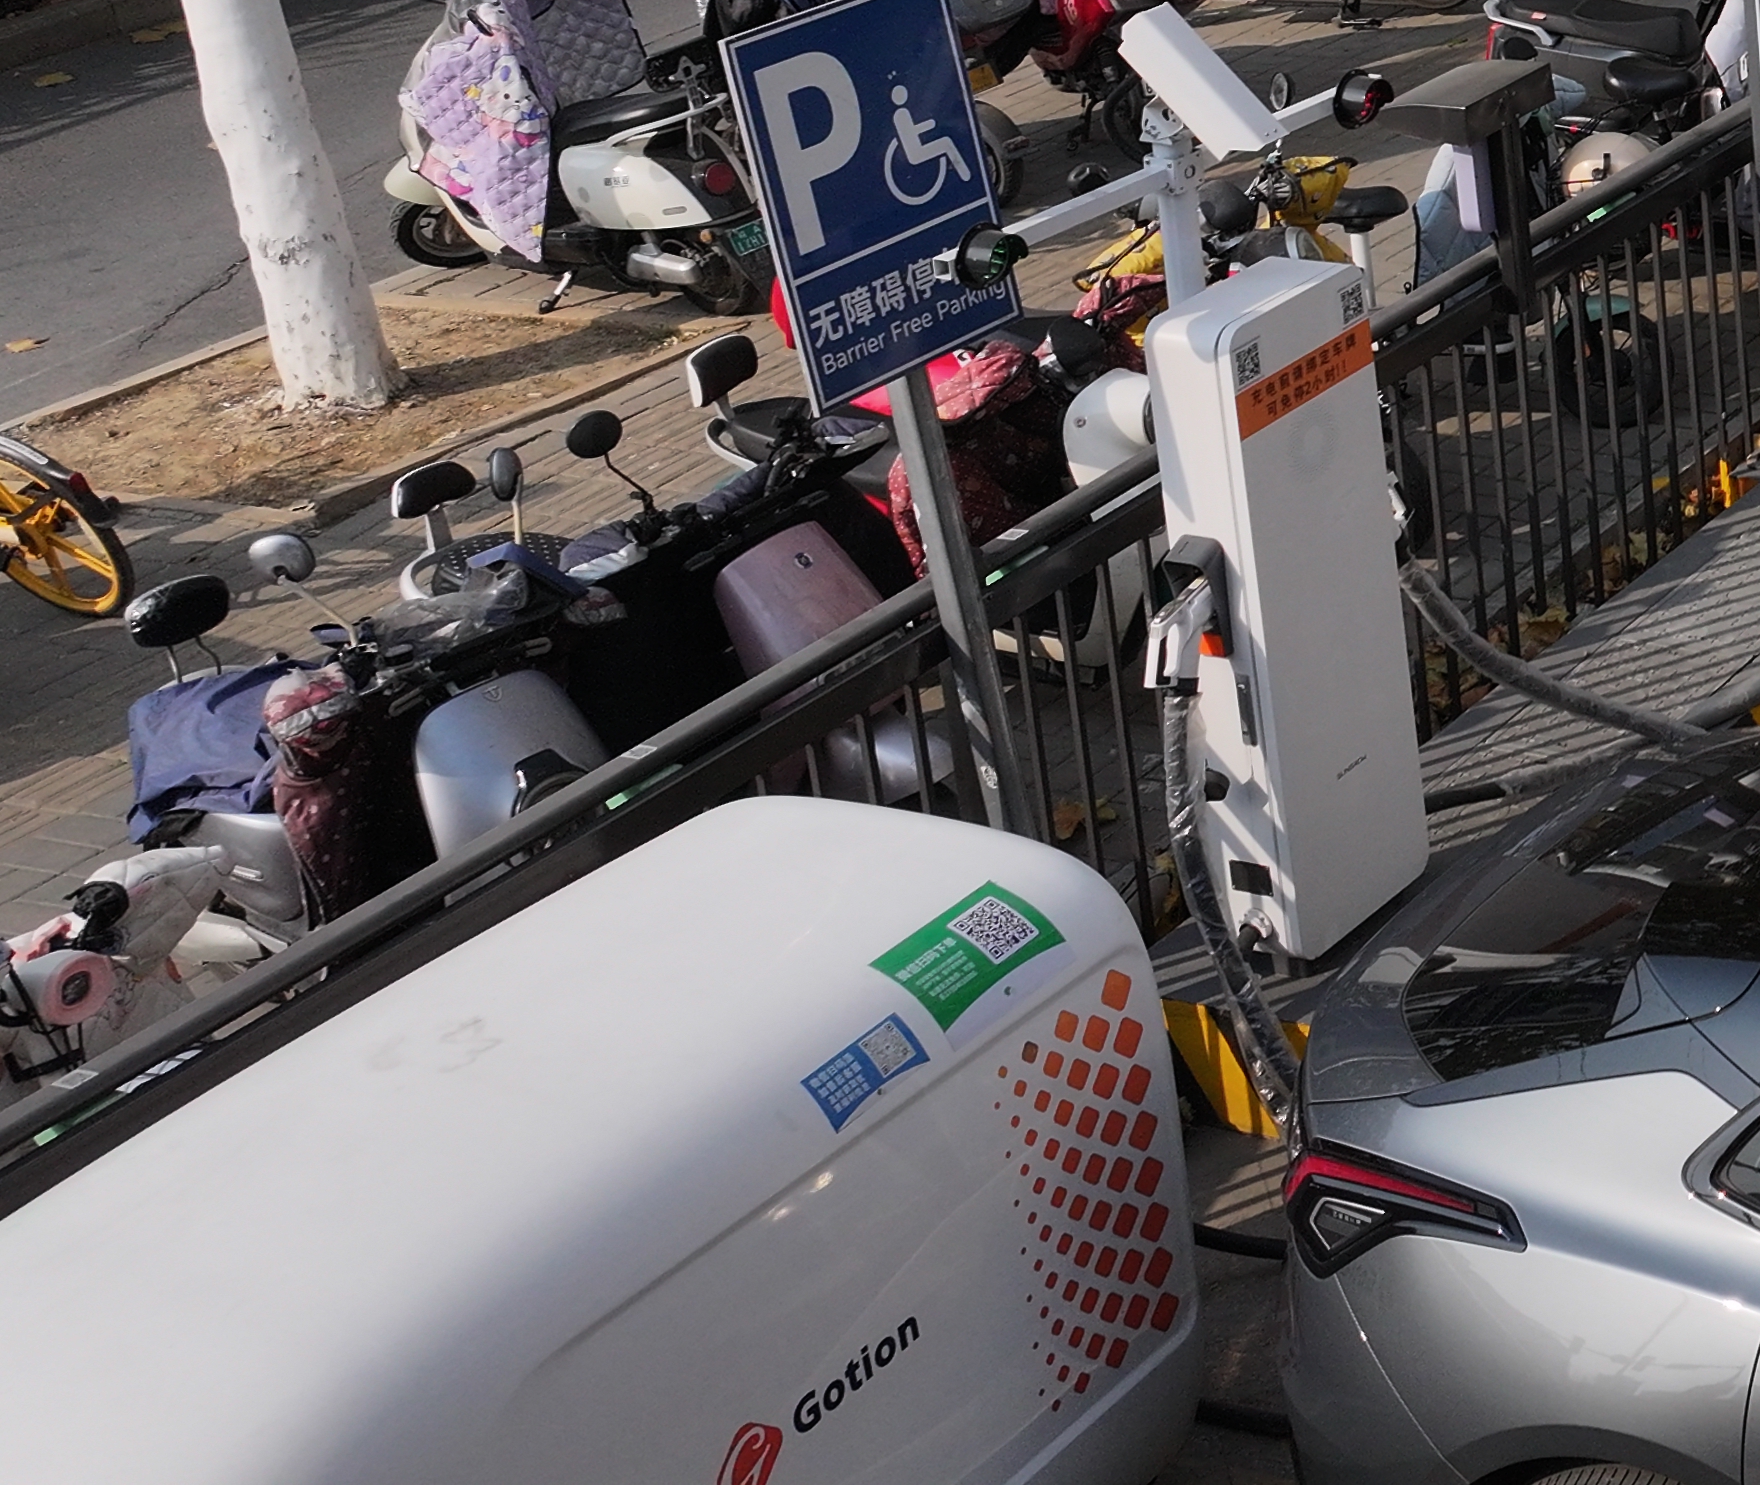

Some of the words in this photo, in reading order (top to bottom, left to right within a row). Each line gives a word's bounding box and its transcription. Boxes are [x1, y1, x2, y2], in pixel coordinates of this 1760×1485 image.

[753, 50, 862, 256] P
[809, 247, 964, 349] 无障碍停
[821, 330, 886, 376] Barrier
[889, 310, 934, 345] Free
[937, 280, 1008, 324] Parking
[1250, 333, 1358, 408] 充电前请绑定车牌
[792, 1312, 922, 1436] Gotion
